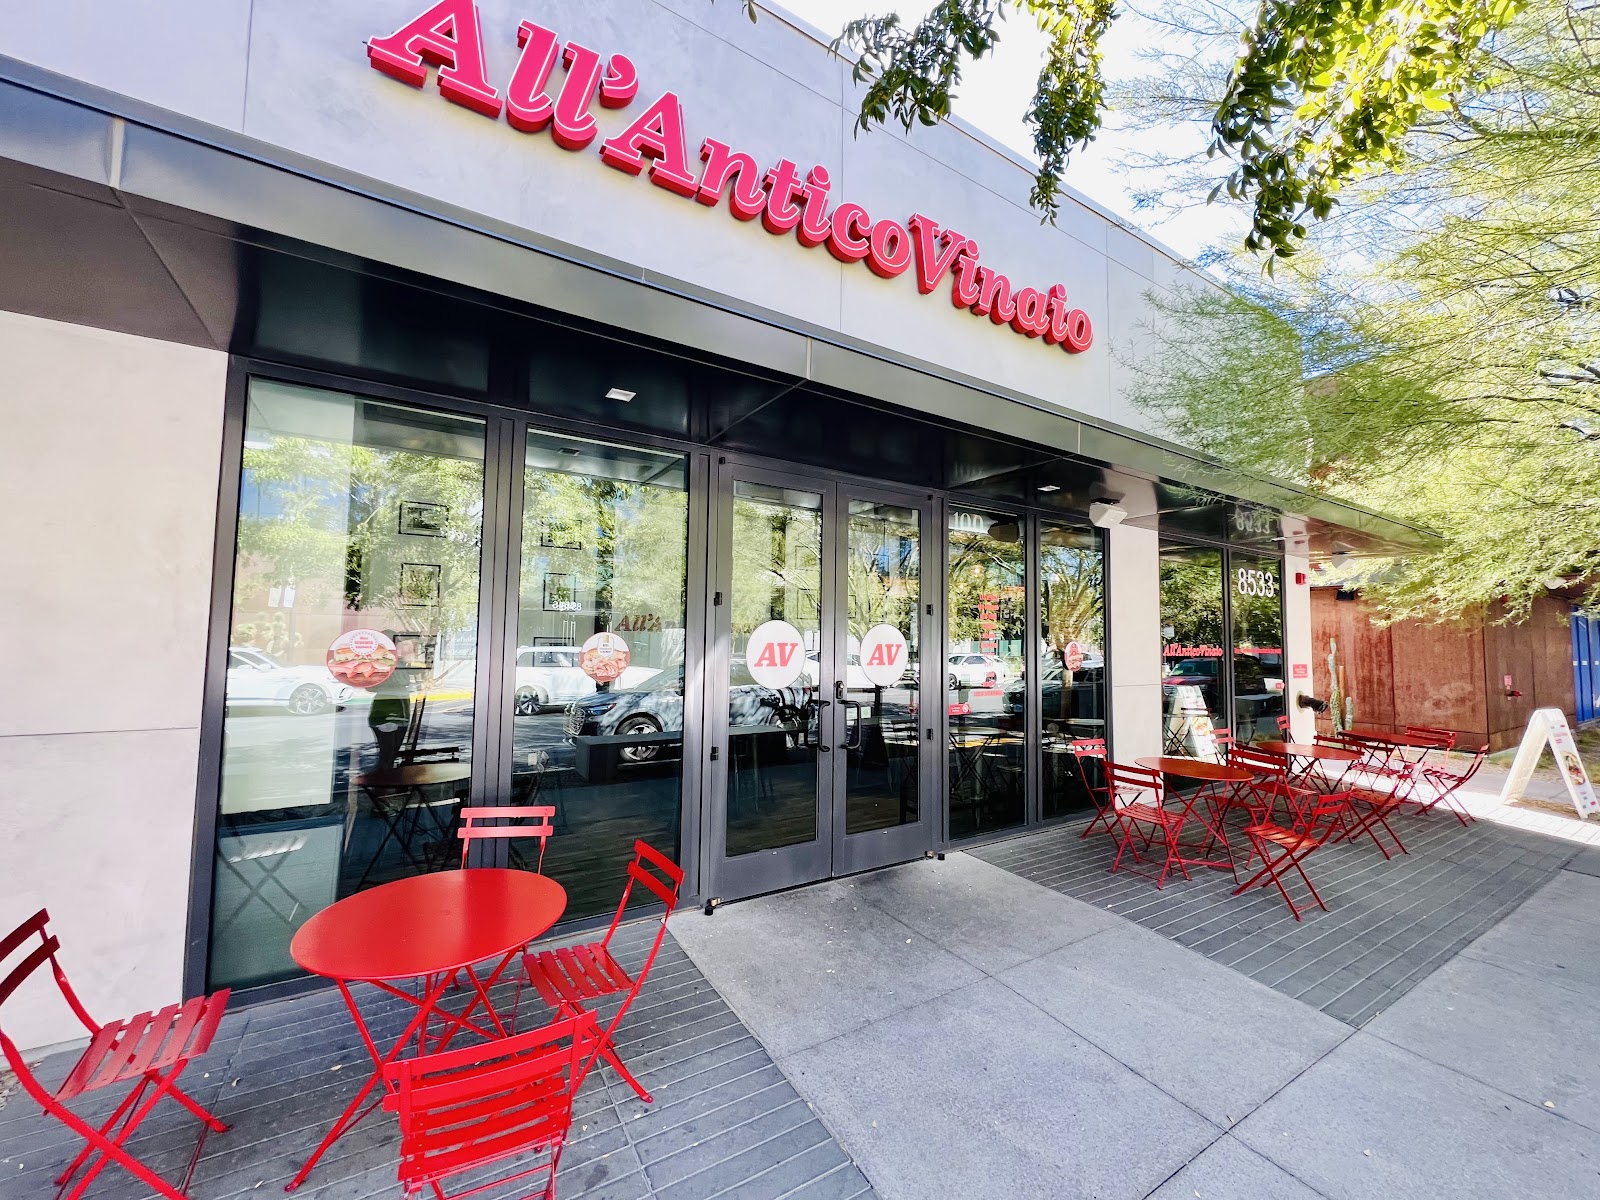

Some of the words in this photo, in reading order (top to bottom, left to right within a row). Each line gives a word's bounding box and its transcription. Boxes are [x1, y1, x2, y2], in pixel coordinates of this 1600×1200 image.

[953, 511, 984, 531] 100
[1237, 567, 1275, 598] 8533
[754, 642, 799, 667] AV
[866, 643, 903, 666] AV
